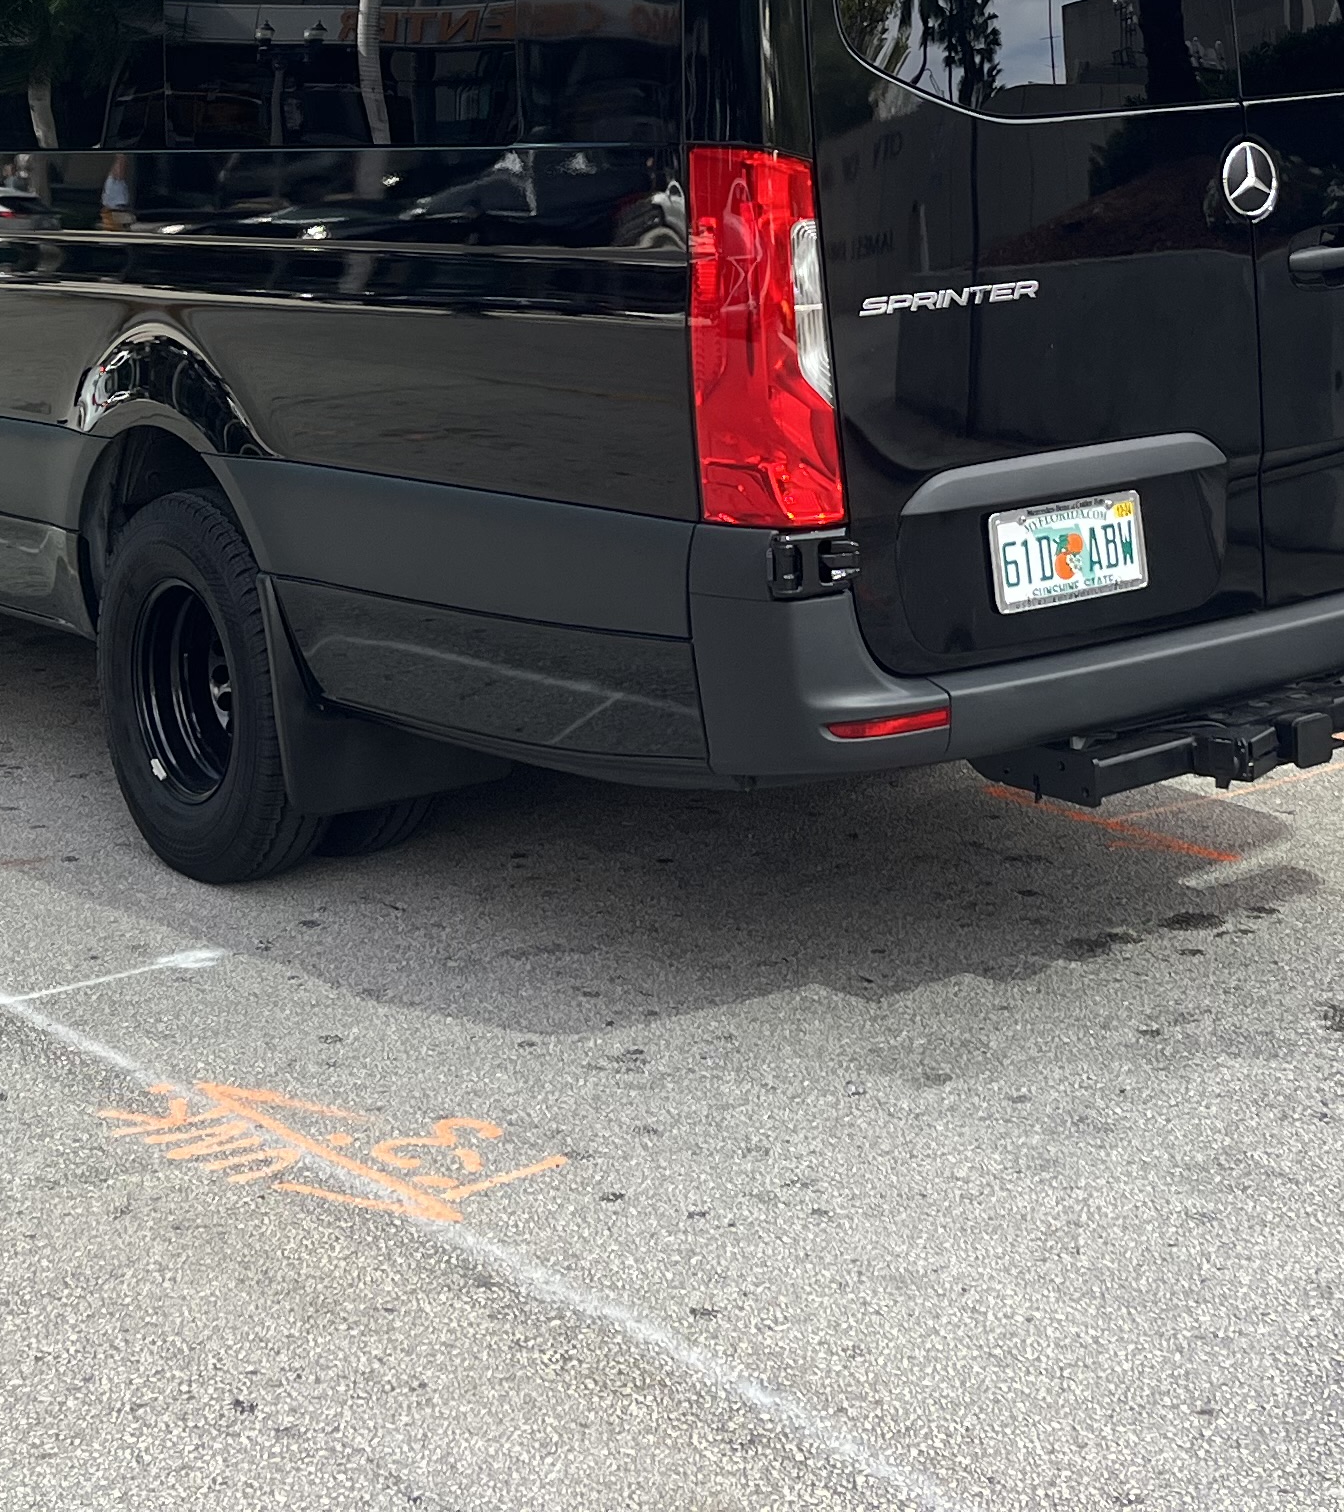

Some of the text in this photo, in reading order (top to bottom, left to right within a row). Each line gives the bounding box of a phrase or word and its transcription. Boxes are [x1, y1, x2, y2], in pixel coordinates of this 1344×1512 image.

[858, 279, 1040, 317] SPRINTER
[1002, 519, 1134, 588] 61D ABW
[1032, 580, 1080, 597] SUNSHINE
[1083, 574, 1114, 587] STATE
